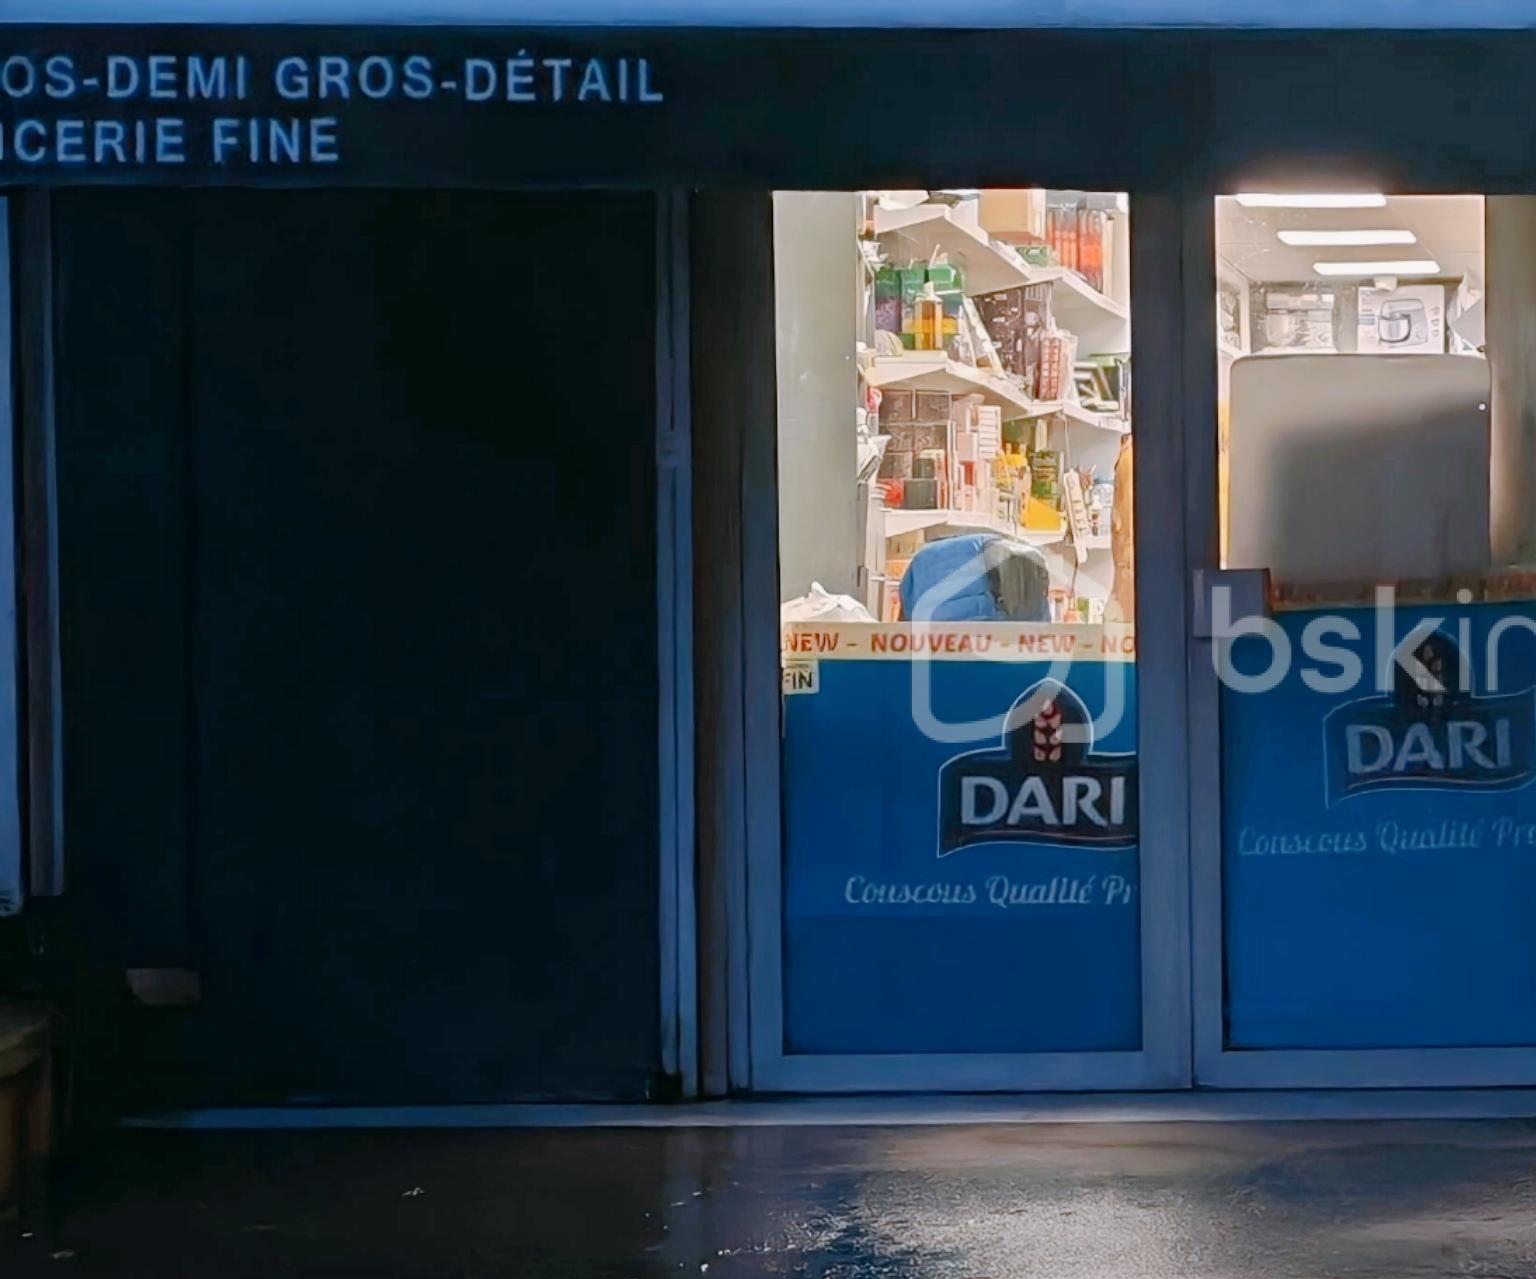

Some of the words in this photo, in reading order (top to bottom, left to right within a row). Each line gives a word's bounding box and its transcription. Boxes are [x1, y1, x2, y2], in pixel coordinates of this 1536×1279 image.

[274, 49, 664, 102] GROS-DÉTAIL
[211, 118, 339, 163] FINE
[785, 632, 839, 652] NEW
[870, 632, 993, 653] NOUVEAU
[1018, 634, 1076, 653] NEW
[1345, 718, 1511, 774] DARI
[960, 775, 1126, 827] DARI
[1238, 825, 1368, 856] Couscous
[845, 876, 977, 905] Couscous
[986, 874, 1097, 909] Qualité
